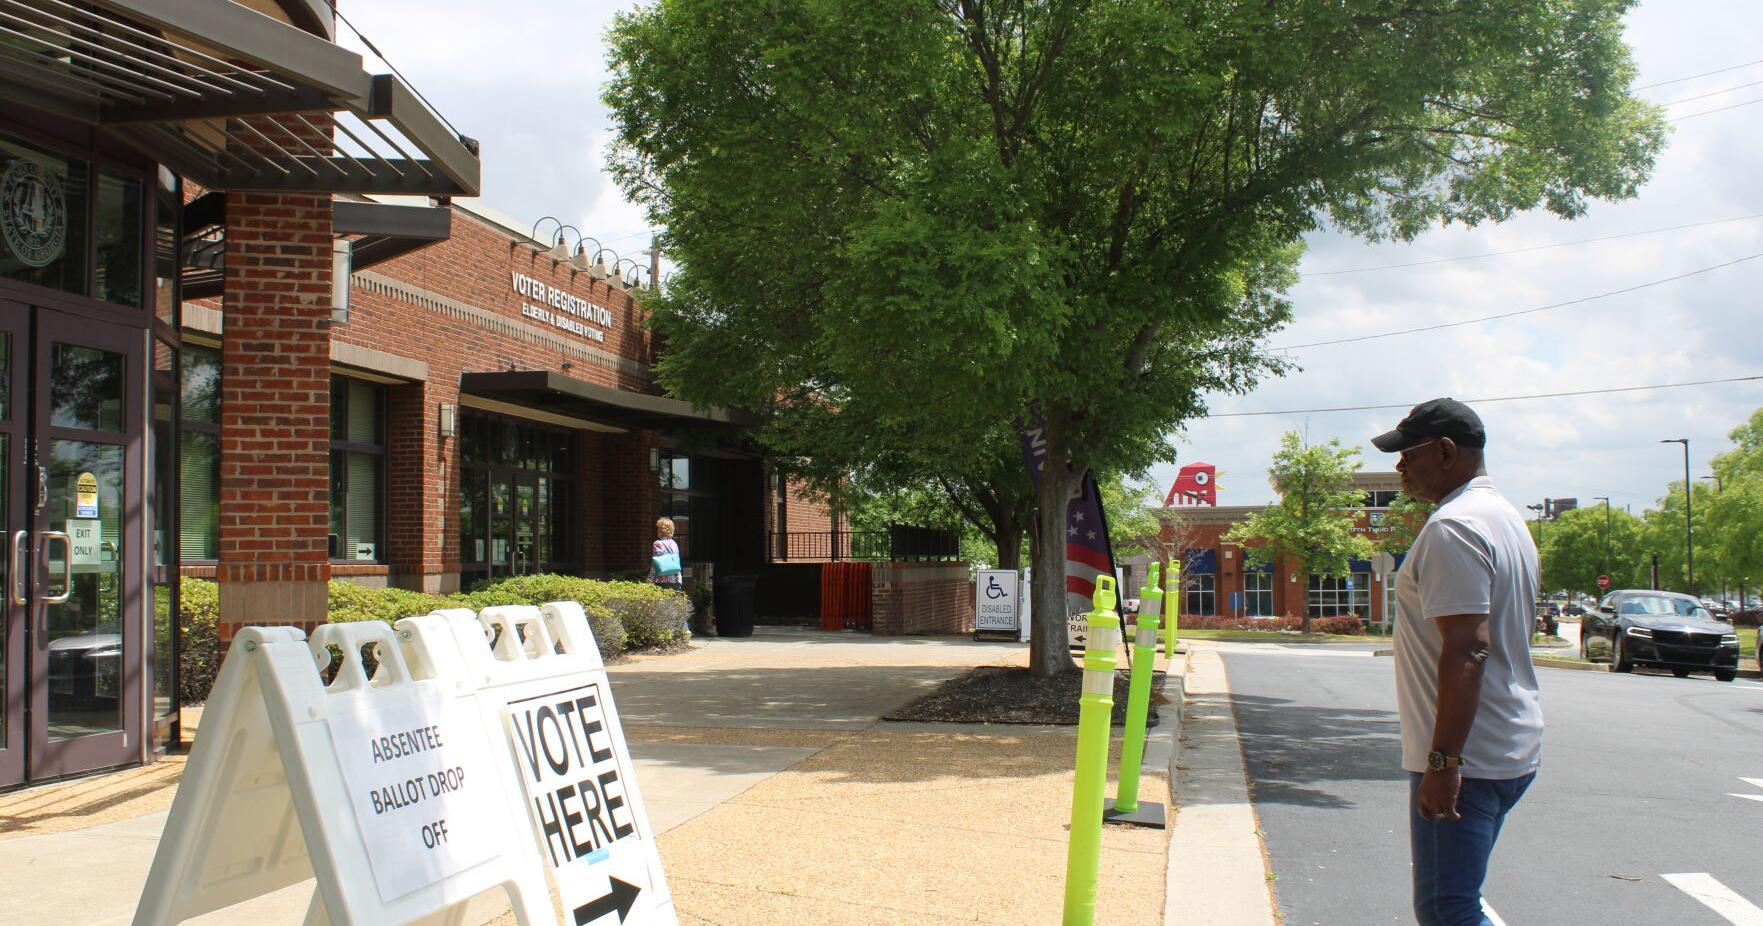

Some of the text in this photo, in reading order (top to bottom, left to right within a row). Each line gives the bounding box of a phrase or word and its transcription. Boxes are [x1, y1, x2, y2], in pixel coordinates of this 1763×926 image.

[511, 270, 613, 328] VOTER REGISTRATION
[522, 302, 604, 342] ELDERLY & DISABLED VOTING
[74, 546, 93, 556] ONLY
[76, 528, 91, 538] EXIT
[979, 616, 1013, 626] ENTRANCE
[981, 604, 1012, 614] DISABLED
[371, 725, 444, 764] ABSENTEE
[511, 694, 613, 783] VOTE
[370, 766, 465, 815] BALLOT DROP
[421, 819, 448, 849] OFF
[534, 769, 635, 869] HERE
